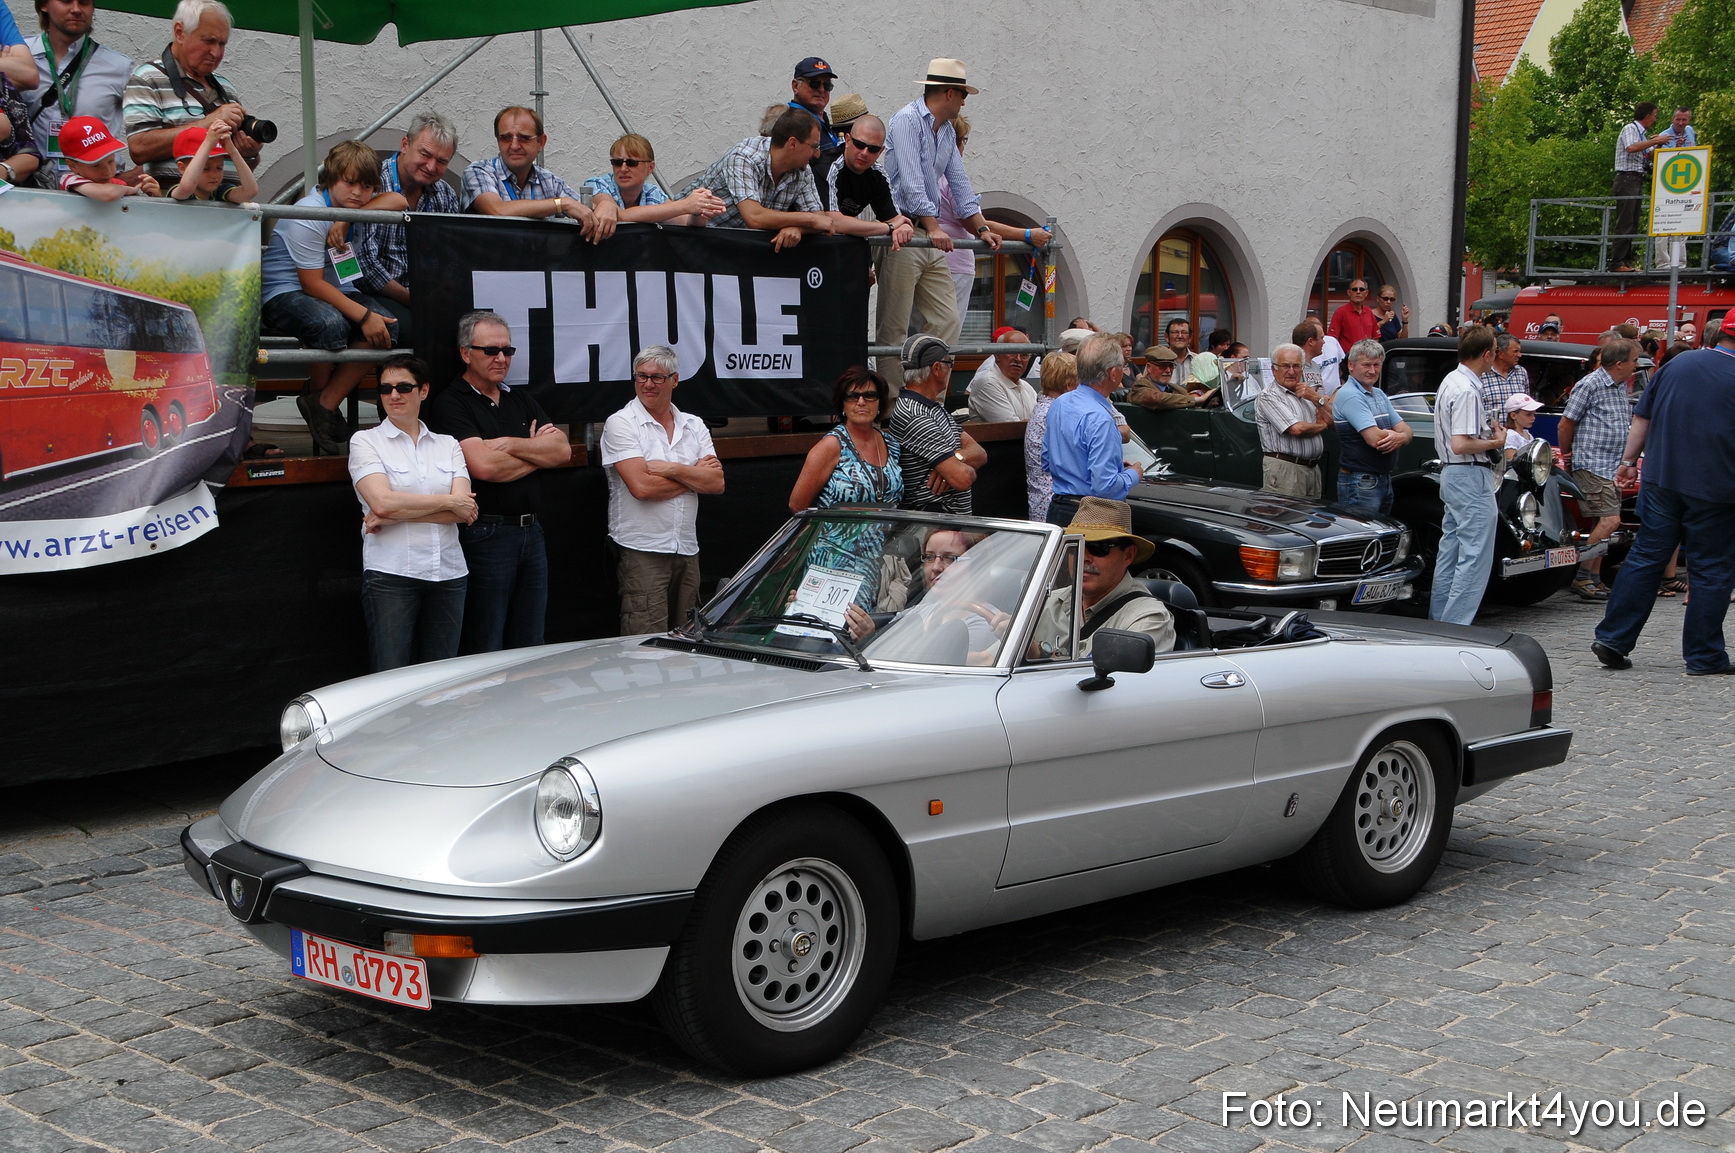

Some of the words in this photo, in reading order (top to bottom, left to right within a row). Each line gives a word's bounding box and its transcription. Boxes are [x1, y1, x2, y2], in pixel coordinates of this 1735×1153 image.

[81, 131, 107, 147] DEKRA
[1671, 163, 1692, 185] H
[472, 271, 803, 385] THULE
[725, 353, 793, 371] SWEDEN
[0, 505, 218, 559] w.arzt-reisen.
[822, 586, 849, 607] 307
[296, 957, 302, 967] D
[306, 939, 340, 981] RH
[353, 953, 423, 1000] 0793
